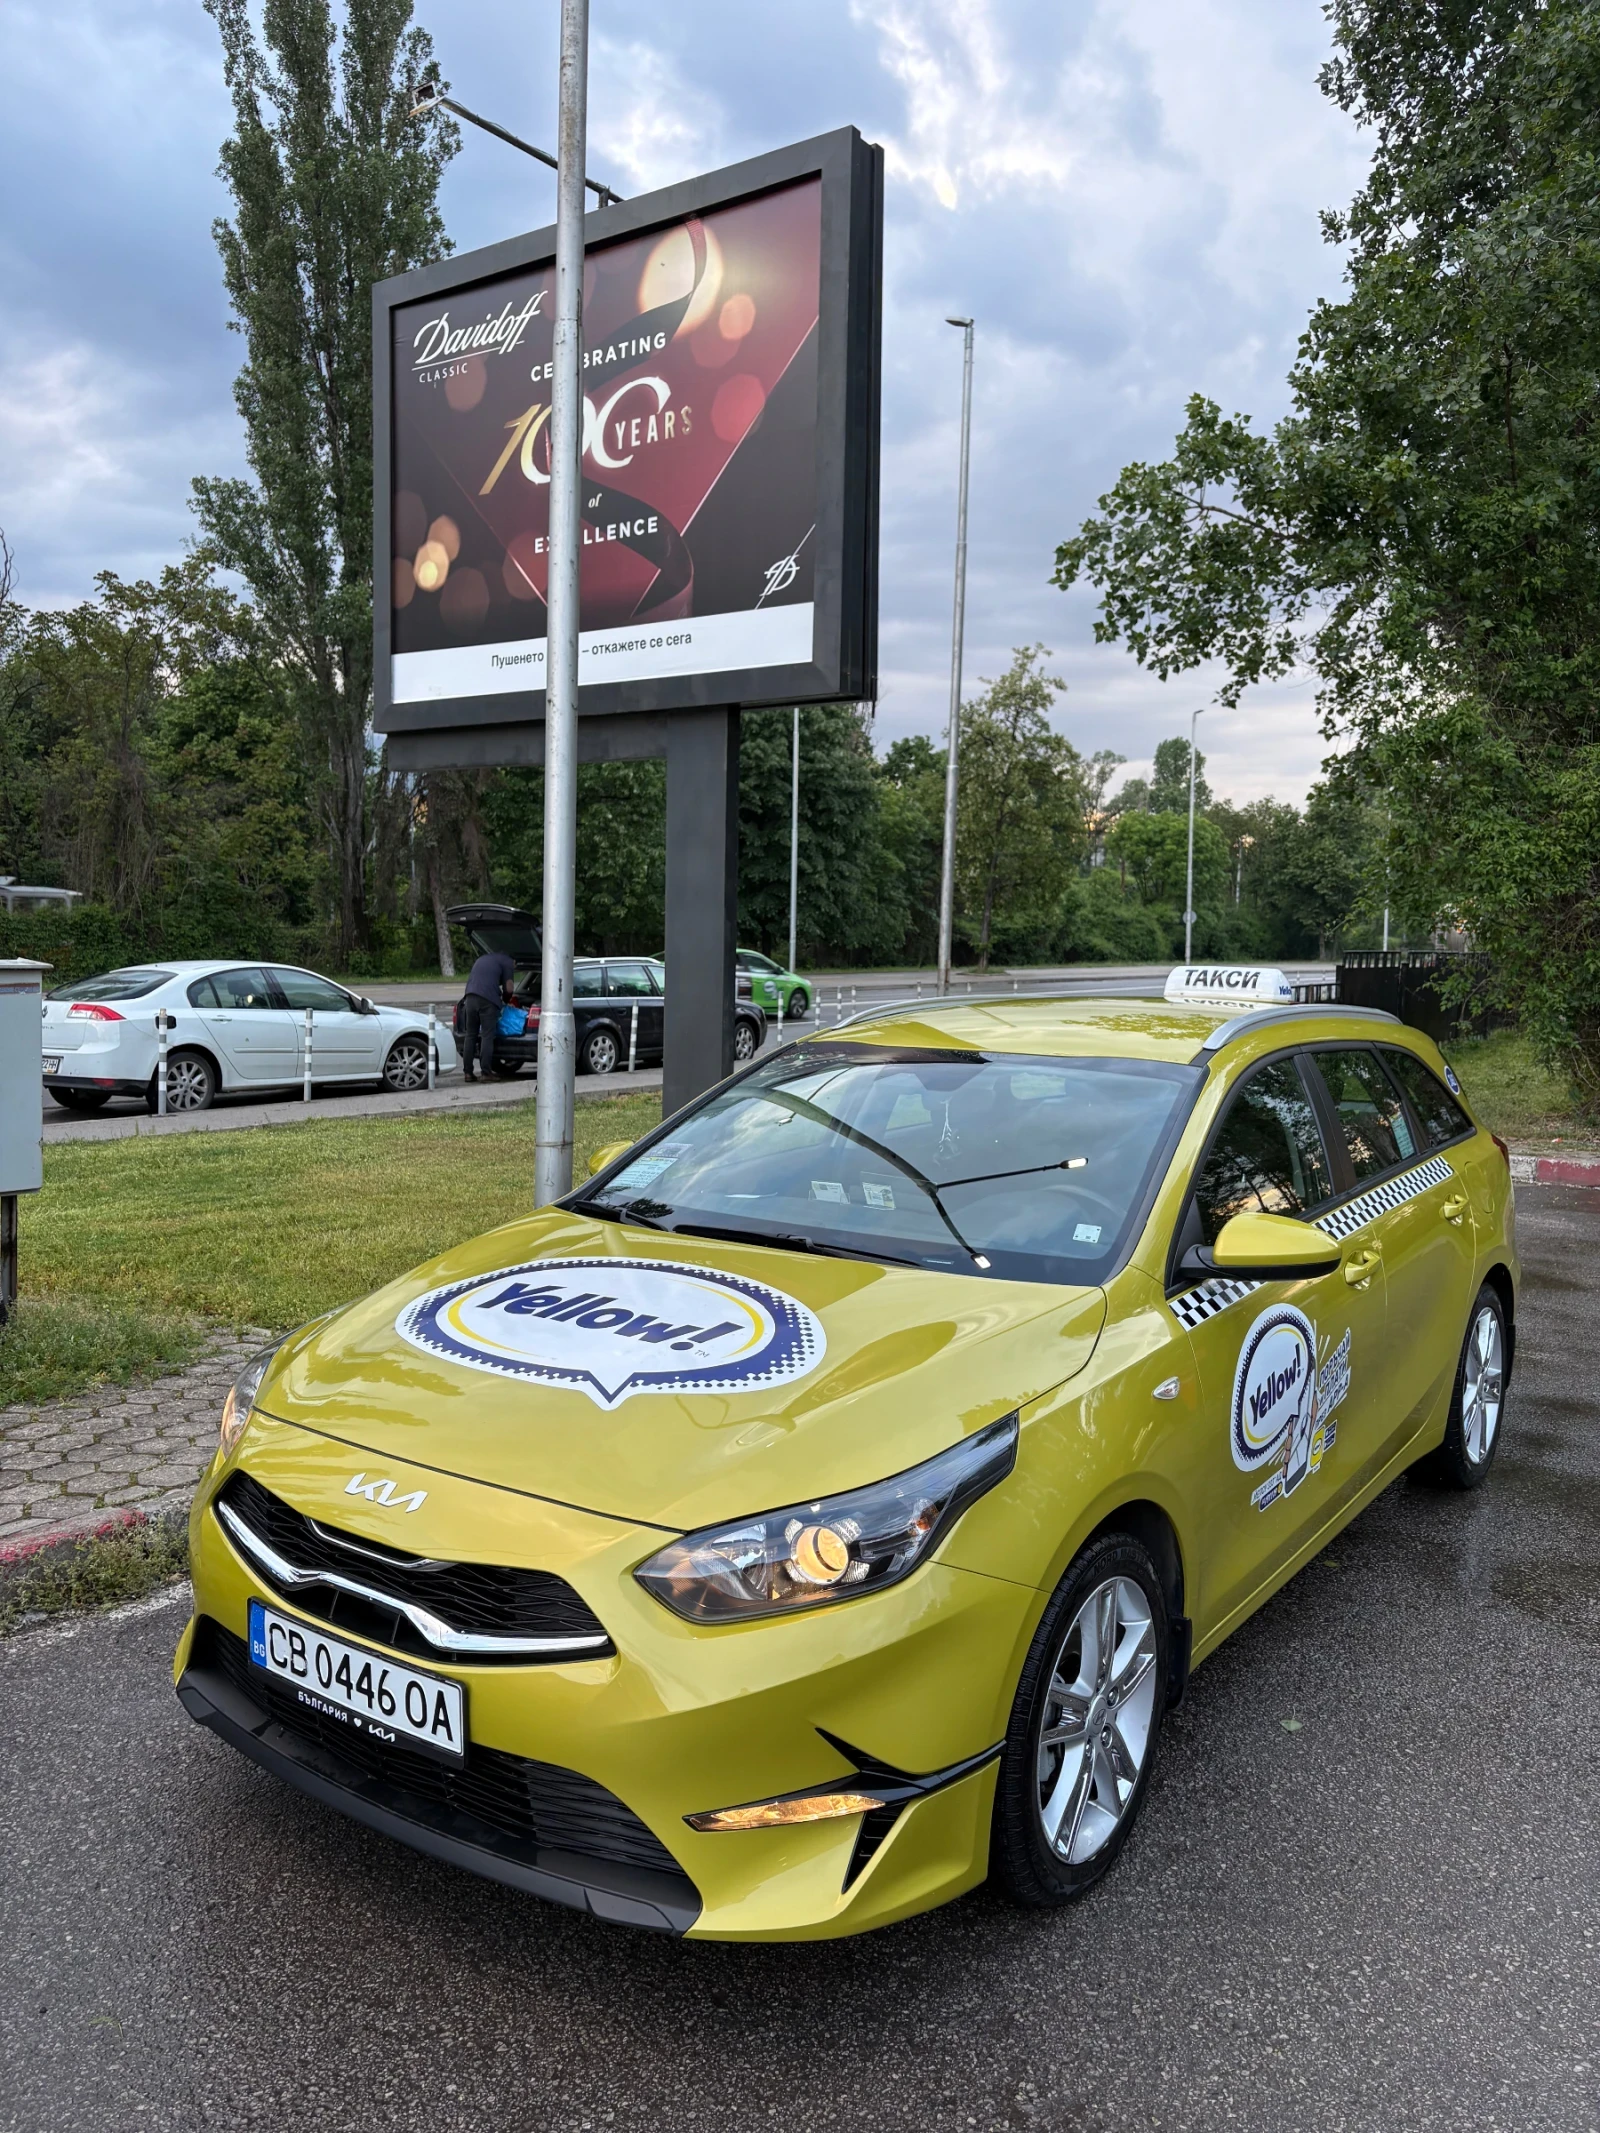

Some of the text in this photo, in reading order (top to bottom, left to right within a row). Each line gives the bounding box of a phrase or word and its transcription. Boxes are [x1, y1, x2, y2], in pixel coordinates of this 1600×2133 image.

[414, 290, 548, 364] Davidoff
[419, 362, 468, 383] CLASSIC
[531, 332, 666, 382] CEBRATING
[615, 405, 692, 450] YEARS
[588, 493, 602, 508] of
[534, 516, 658, 553] ELLENCE
[491, 651, 544, 668] Пушенето
[591, 639, 646, 656] откажете
[650, 637, 663, 648] се
[666, 633, 692, 647] сега
[1184, 969, 1261, 989] ТАКСИ
[476, 1282, 745, 1351] Yellow!
[1250, 1343, 1301, 1427] Yellow!
[253, 1640, 266, 1658] BG
[269, 1622, 454, 1742] CB 0446 OA
[298, 1690, 348, 1723] БЪЛГАРИЯ
